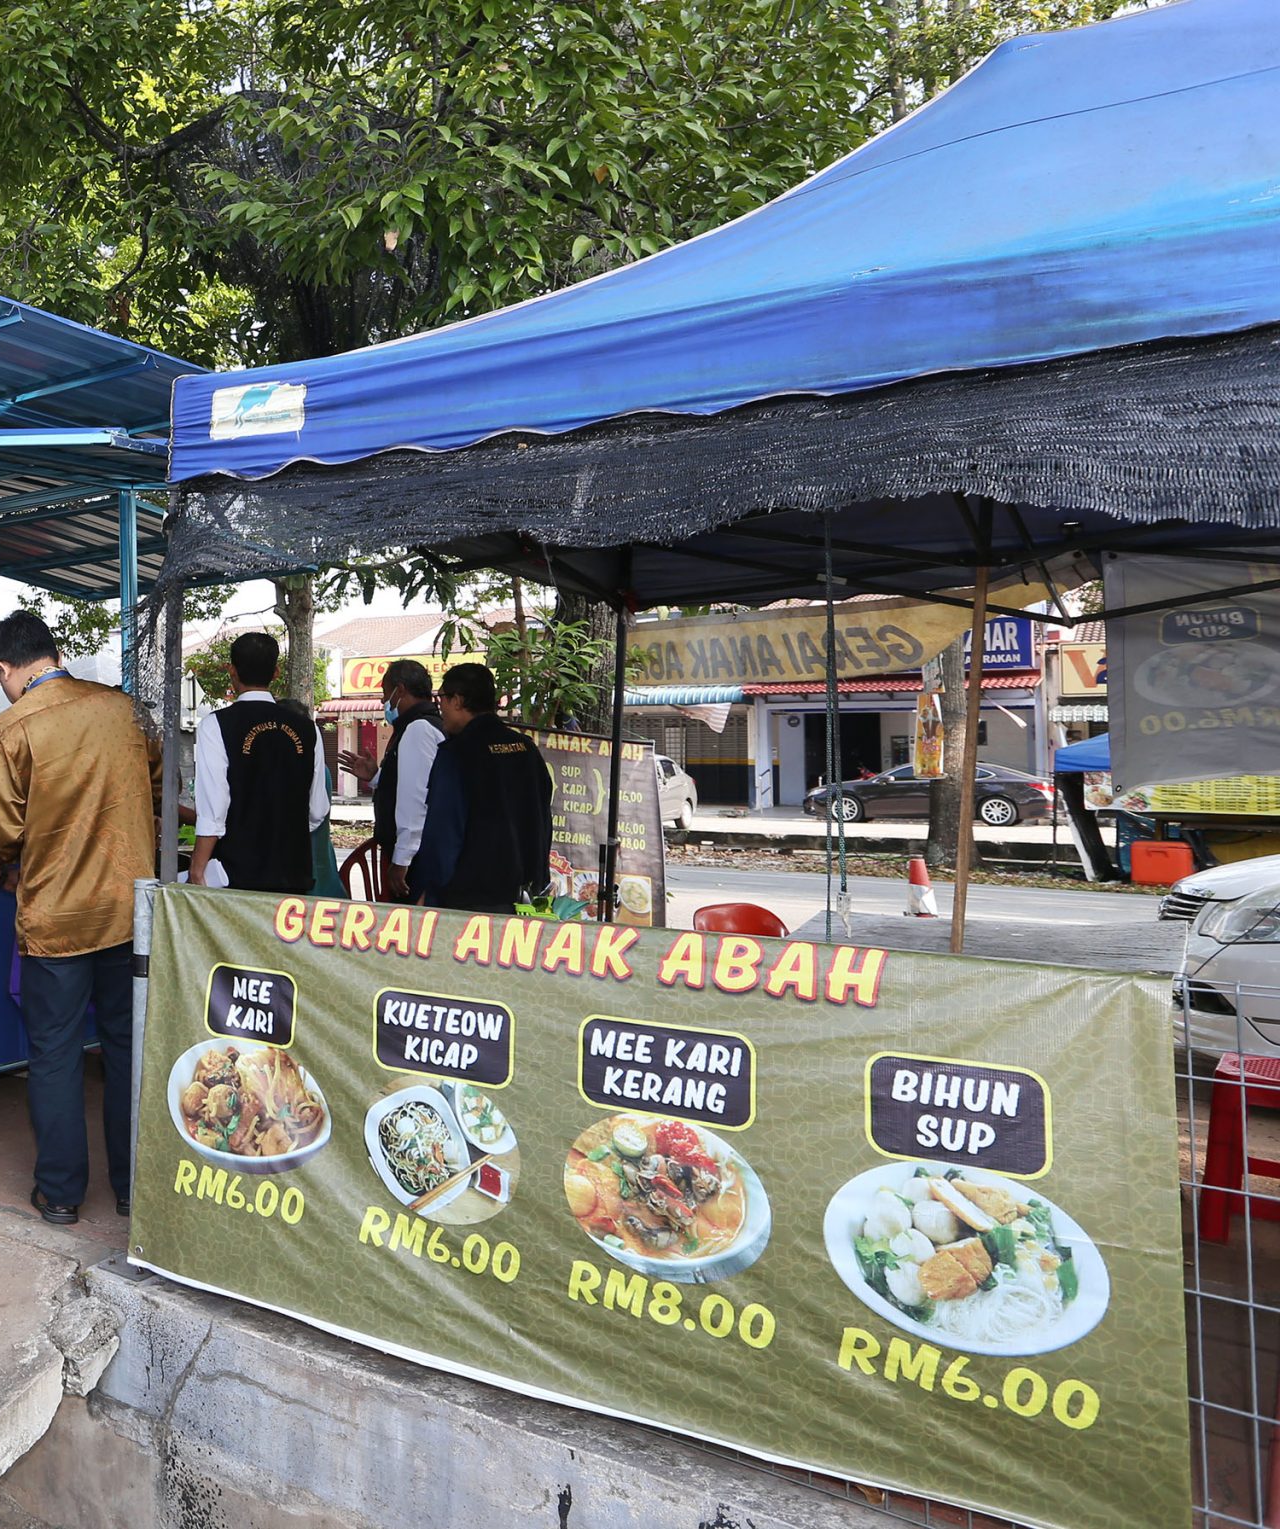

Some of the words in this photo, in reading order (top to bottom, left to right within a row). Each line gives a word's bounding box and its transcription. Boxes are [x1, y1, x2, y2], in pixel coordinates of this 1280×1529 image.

[546, 732, 593, 754] ANAK
[598, 740, 644, 762] AAH
[561, 765, 581, 778] SUP
[562, 782, 587, 796] KARI
[563, 799, 593, 814] KICAP
[552, 830, 592, 846] KERANG
[274, 896, 440, 958] GERAI
[452, 913, 640, 979] ANAK
[658, 931, 889, 1008] ABAH
[231, 975, 274, 1005] MEE
[225, 1005, 275, 1035] KARI
[382, 999, 504, 1041] KUETEOW
[403, 1034, 479, 1071] KICAP
[589, 1027, 655, 1063] MEE
[664, 1038, 743, 1077] KARI
[602, 1066, 727, 1115] KERANG
[890, 1068, 1021, 1118] BIHUN
[915, 1113, 997, 1155] SUP
[173, 1159, 306, 1226] RM6.00
[358, 1205, 522, 1286] RM6.00
[566, 1259, 777, 1350] RM8.00
[836, 1326, 1101, 1431] RM6.00
